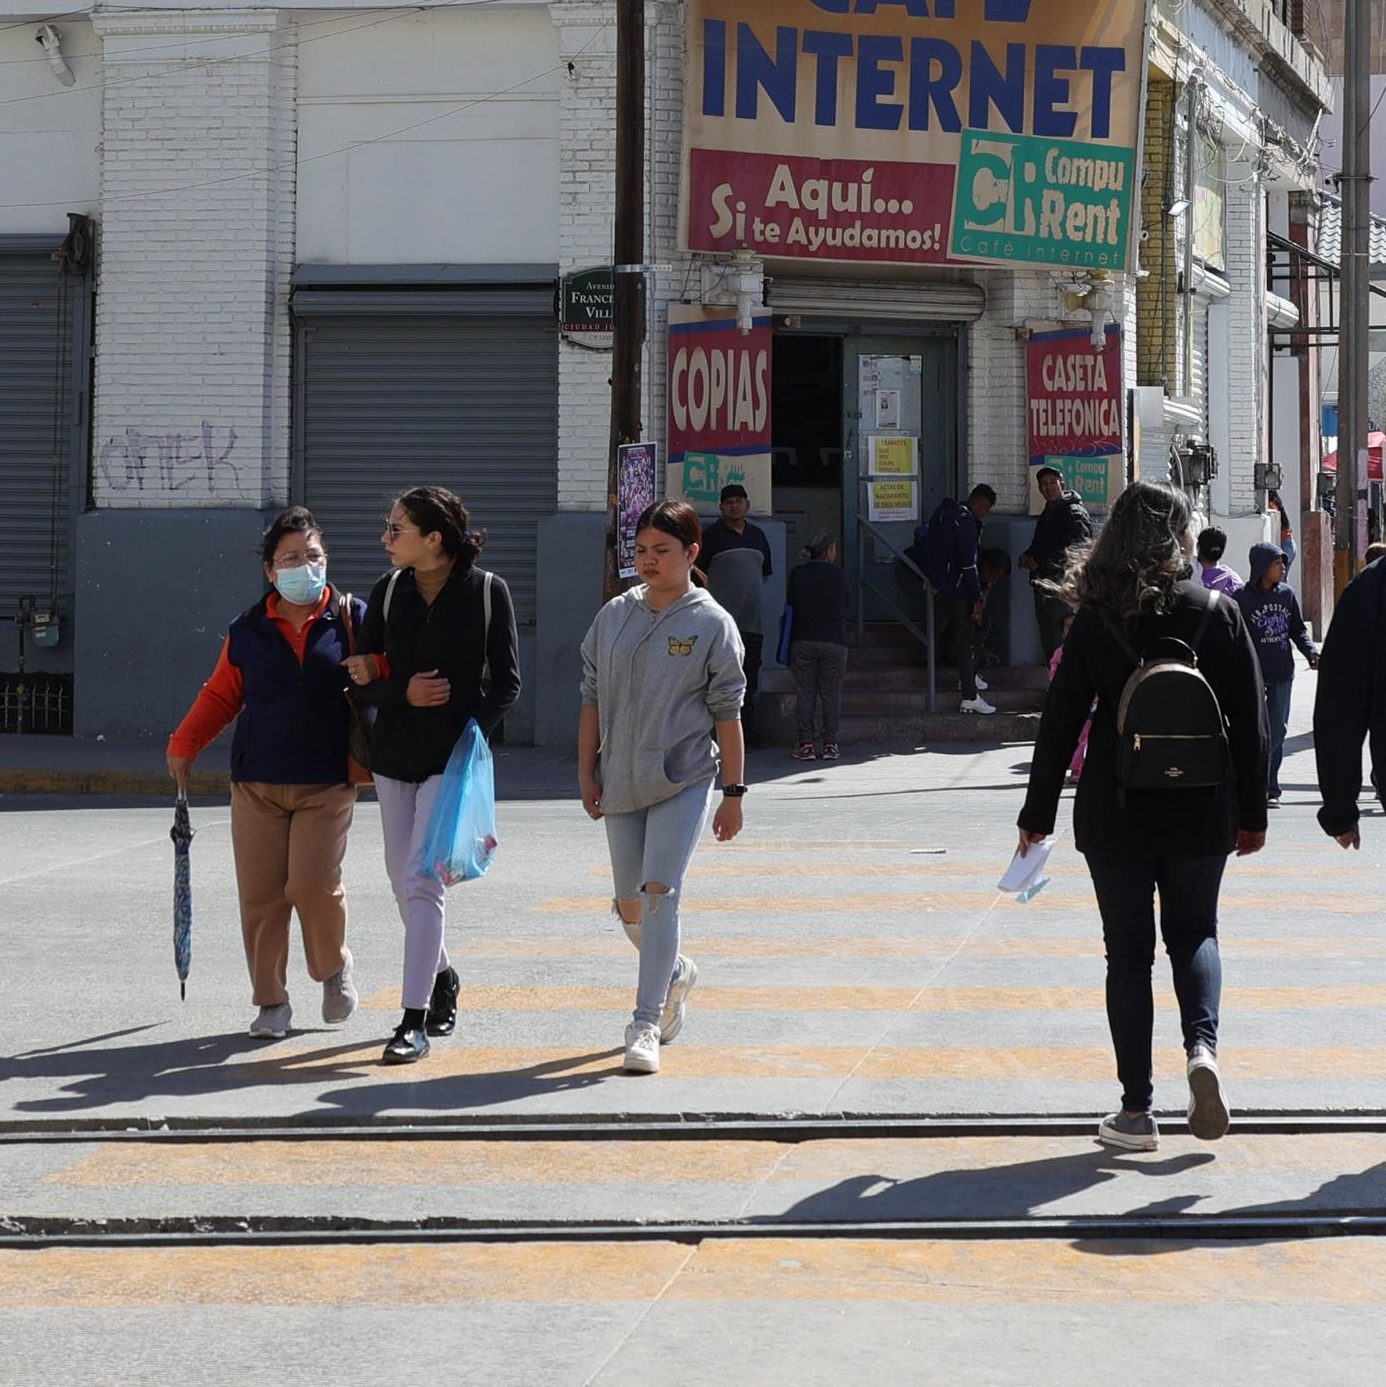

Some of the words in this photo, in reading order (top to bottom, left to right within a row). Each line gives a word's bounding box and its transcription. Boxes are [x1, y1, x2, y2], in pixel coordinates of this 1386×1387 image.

[702, 18, 1126, 139] INTERNET
[1045, 147, 1125, 191] Compu
[765, 164, 913, 220] Aquí...
[709, 183, 746, 241] Si
[752, 217, 781, 243] te
[786, 217, 942, 252] Ayudamos!
[1039, 188, 1122, 245] Rent
[960, 235, 1014, 256] Café
[1027, 243, 1119, 265] Internet
[571, 291, 614, 304] FRANCI
[586, 282, 614, 290] AVENID
[585, 306, 613, 318] VILL
[672, 346, 767, 432] COPIAS
[1042, 354, 1108, 392] CASETA
[1030, 398, 1121, 436] TELEFONICA
[1075, 475, 1105, 495] Rent
